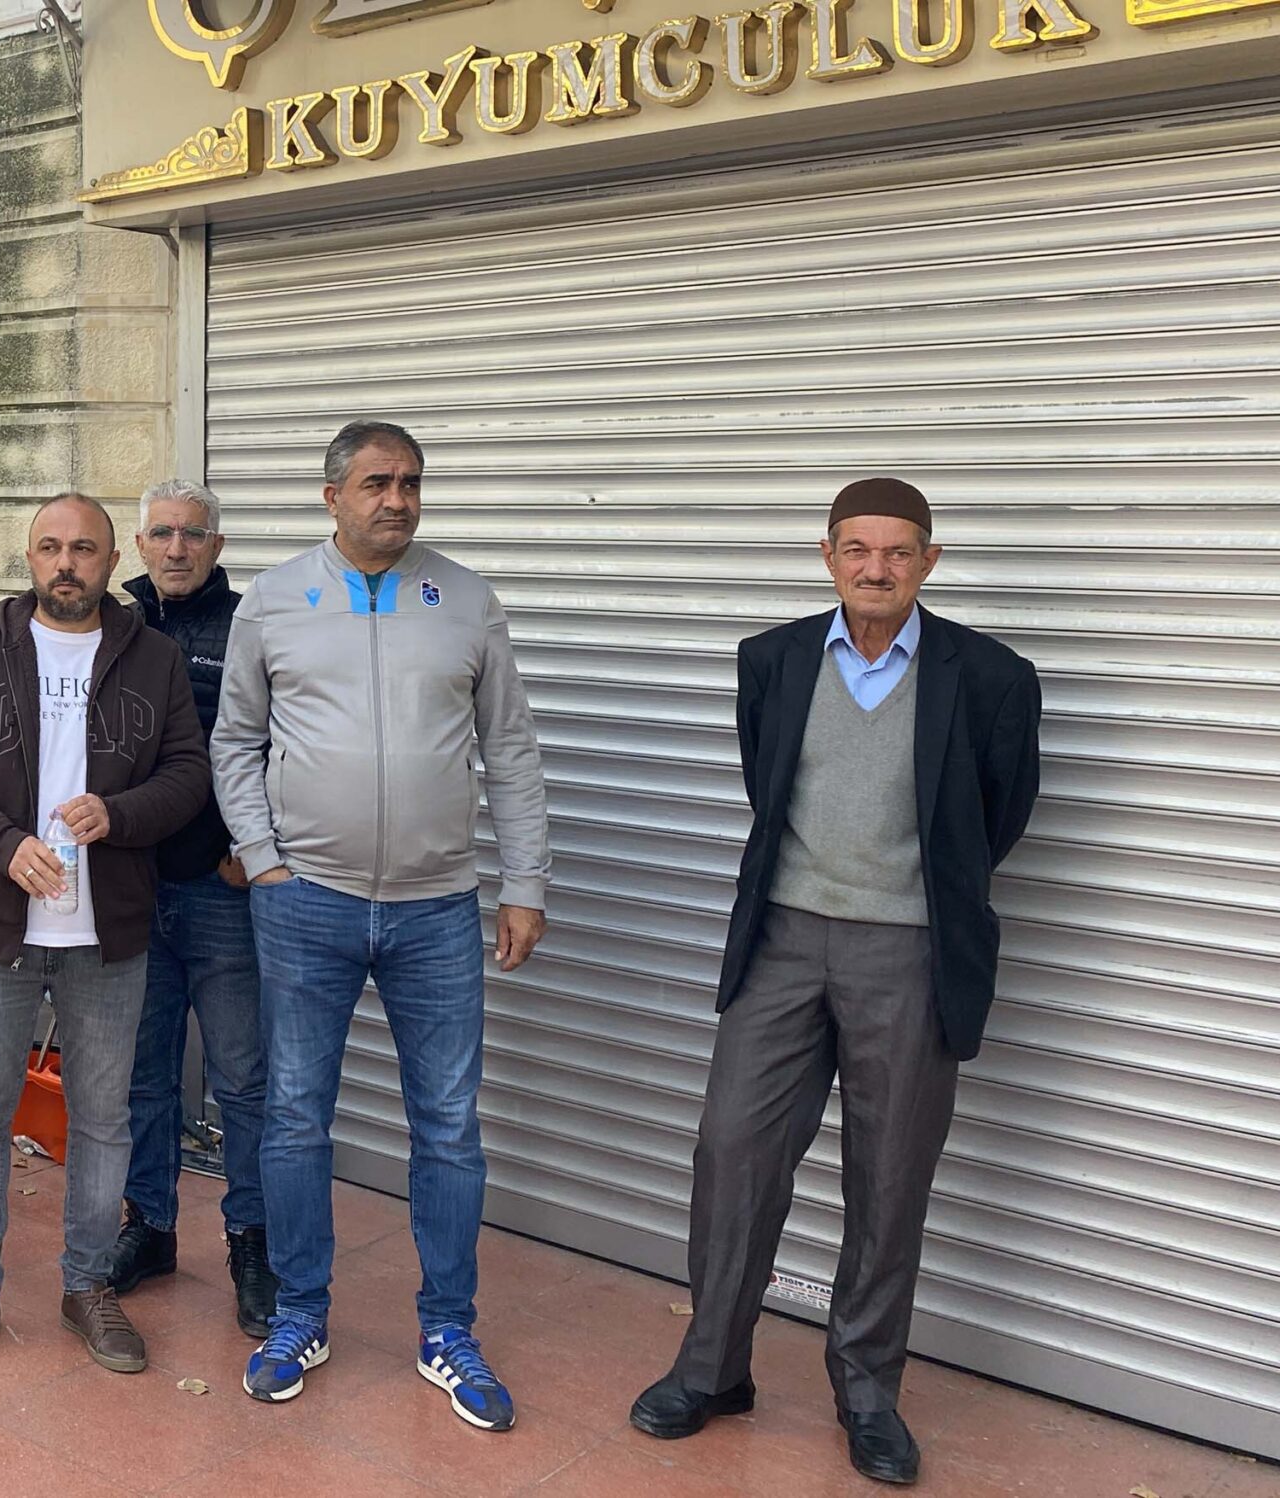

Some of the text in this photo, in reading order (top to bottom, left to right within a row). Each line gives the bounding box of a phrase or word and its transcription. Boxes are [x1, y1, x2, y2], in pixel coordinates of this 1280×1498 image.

[266, 0, 1094, 172] KUYUMCULUK
[198, 656, 224, 668] Columbi
[53, 700, 70, 709] NEW
